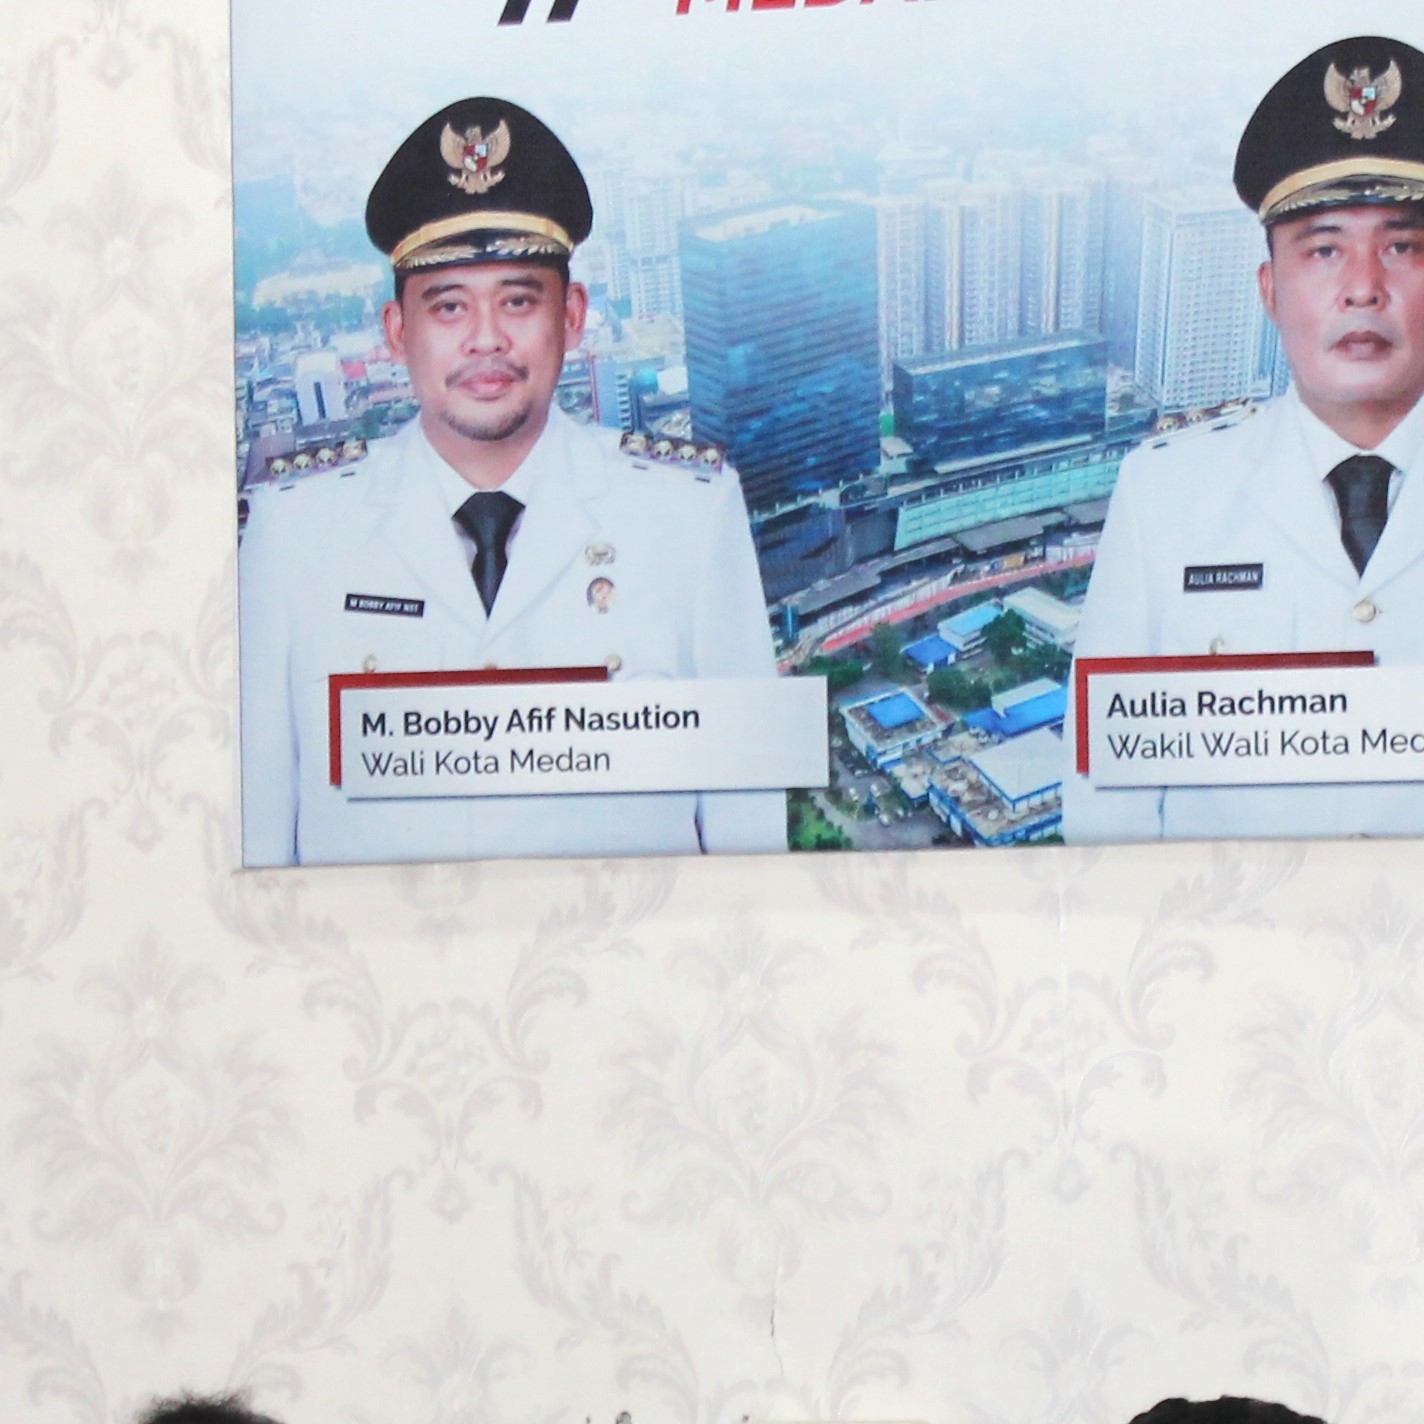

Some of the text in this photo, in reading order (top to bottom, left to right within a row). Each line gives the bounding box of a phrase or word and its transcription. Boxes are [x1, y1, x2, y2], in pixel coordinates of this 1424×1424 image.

[1106, 689, 1348, 719] Aulia Rachman
[361, 704, 701, 741] M. Bobby Afif Nasution
[1107, 731, 1194, 759] Wakil
[1201, 730, 1269, 757] Wali
[1280, 729, 1350, 756] Kota
[361, 747, 611, 778] Wali Kota Medan
